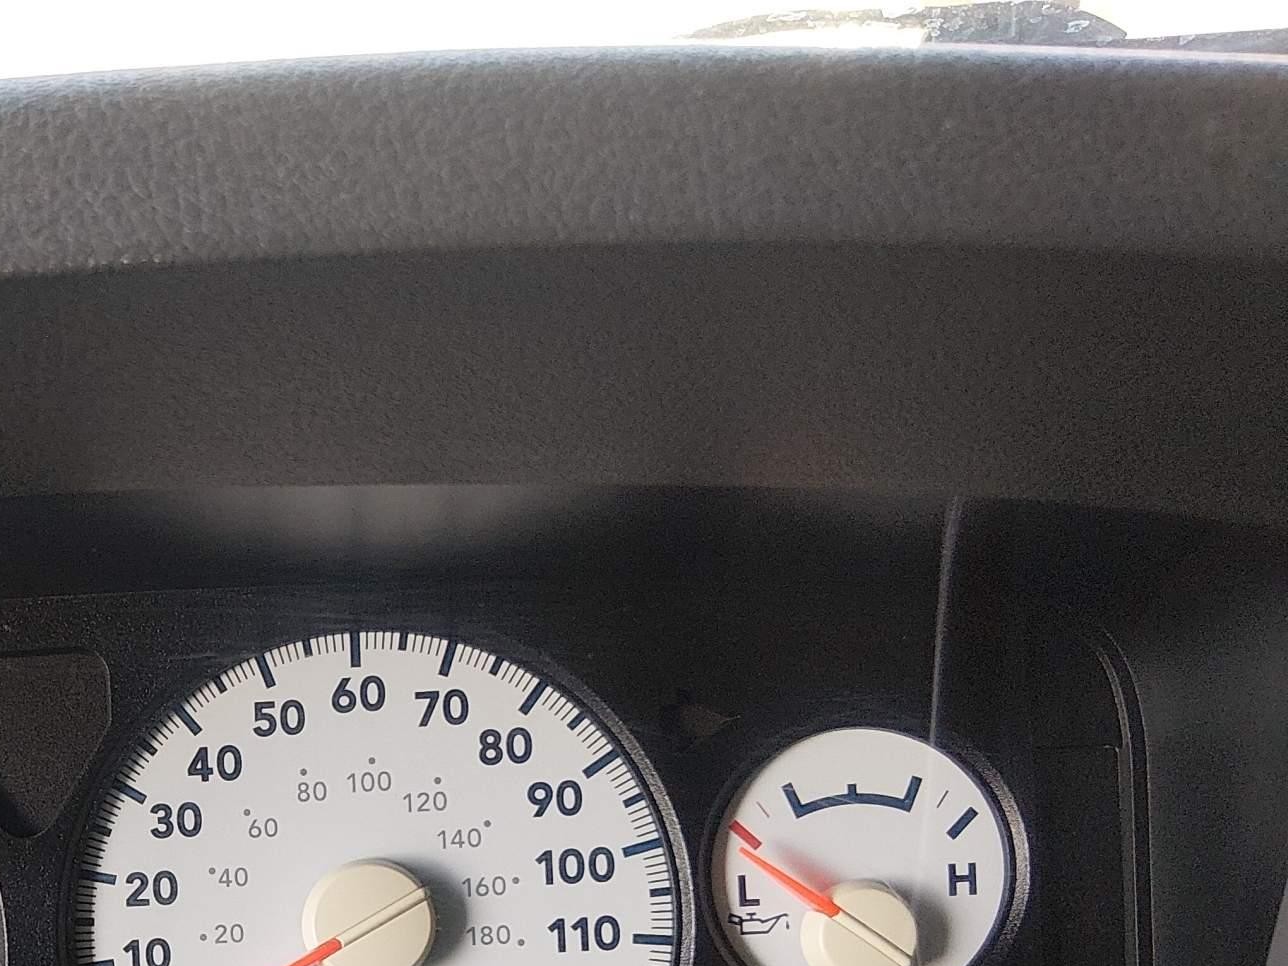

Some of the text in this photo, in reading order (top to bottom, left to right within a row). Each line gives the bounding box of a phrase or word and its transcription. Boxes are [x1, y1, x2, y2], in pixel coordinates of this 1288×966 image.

[330, 675, 386, 713] 60
[414, 689, 470, 727] 70
[253, 700, 306, 736] 50
[187, 745, 243, 783] 40
[478, 727, 534, 766] 80
[296, 780, 328, 803] 80
[346, 770, 392, 794] 100
[527, 779, 583, 817] 90
[150, 801, 202, 838] 30
[403, 790, 449, 814] 120
[247, 816, 279, 840] 60
[438, 827, 482, 851] 140
[217, 866, 249, 890] 40
[536, 845, 615, 885] 100
[947, 862, 978, 897] H
[125, 869, 179, 907] 20
[462, 875, 506, 898] 160
[737, 874, 760, 907] L
[213, 923, 245, 946] 20
[466, 923, 511, 947] 180
[547, 915, 620, 953] 110
